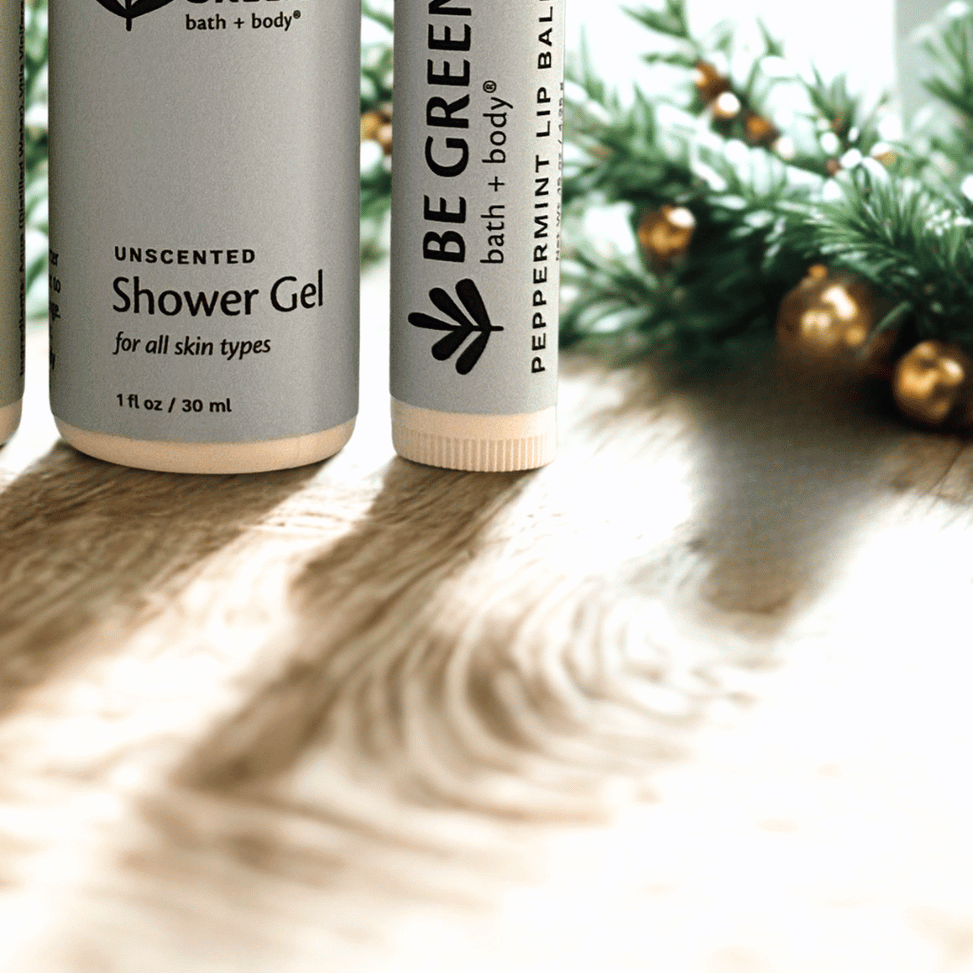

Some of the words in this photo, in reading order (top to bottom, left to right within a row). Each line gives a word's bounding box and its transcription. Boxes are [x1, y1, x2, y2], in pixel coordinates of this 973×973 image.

[185, 13, 227, 31] bath
[233, 17, 245, 29] +
[535, 86, 551, 138] LIP
[487, 175, 505, 193] +
[422, 194, 467, 263] BE
[479, 204, 506, 264] bath
[114, 245, 256, 265] UNSCENTED
[531, 154, 550, 374] PEPPERMINT
[112, 275, 260, 317] Shower
[270, 268, 324, 313] Gel
[112, 330, 141, 356] for
[144, 334, 170, 355] all
[174, 335, 214, 356] skin
[219, 338, 271, 361] types
[116, 393, 123, 407] 1
[127, 393, 140, 410] fl
[143, 399, 163, 412] oz
[167, 397, 176, 414] /
[181, 398, 204, 413] 30
[209, 397, 233, 413] ml
